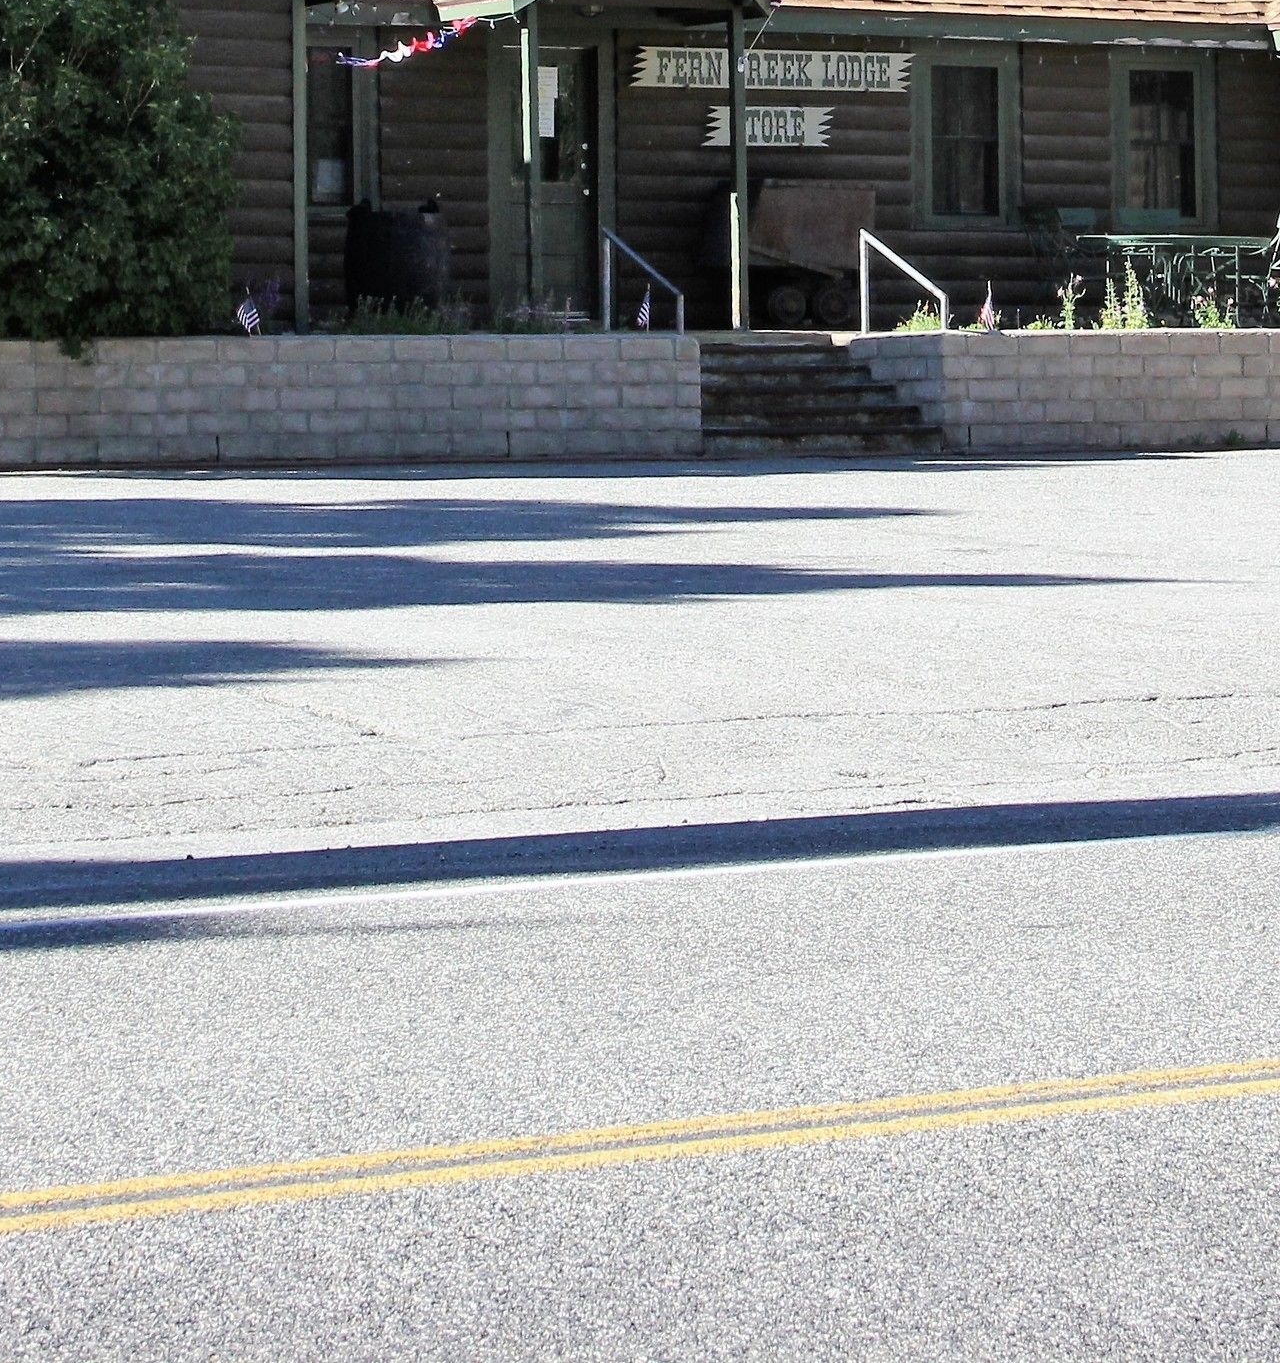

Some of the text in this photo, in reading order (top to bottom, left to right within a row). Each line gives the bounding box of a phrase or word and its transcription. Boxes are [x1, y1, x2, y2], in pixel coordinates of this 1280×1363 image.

[657, 51, 891, 88] FERN REEK LODGE
[745, 110, 805, 143] TORE
